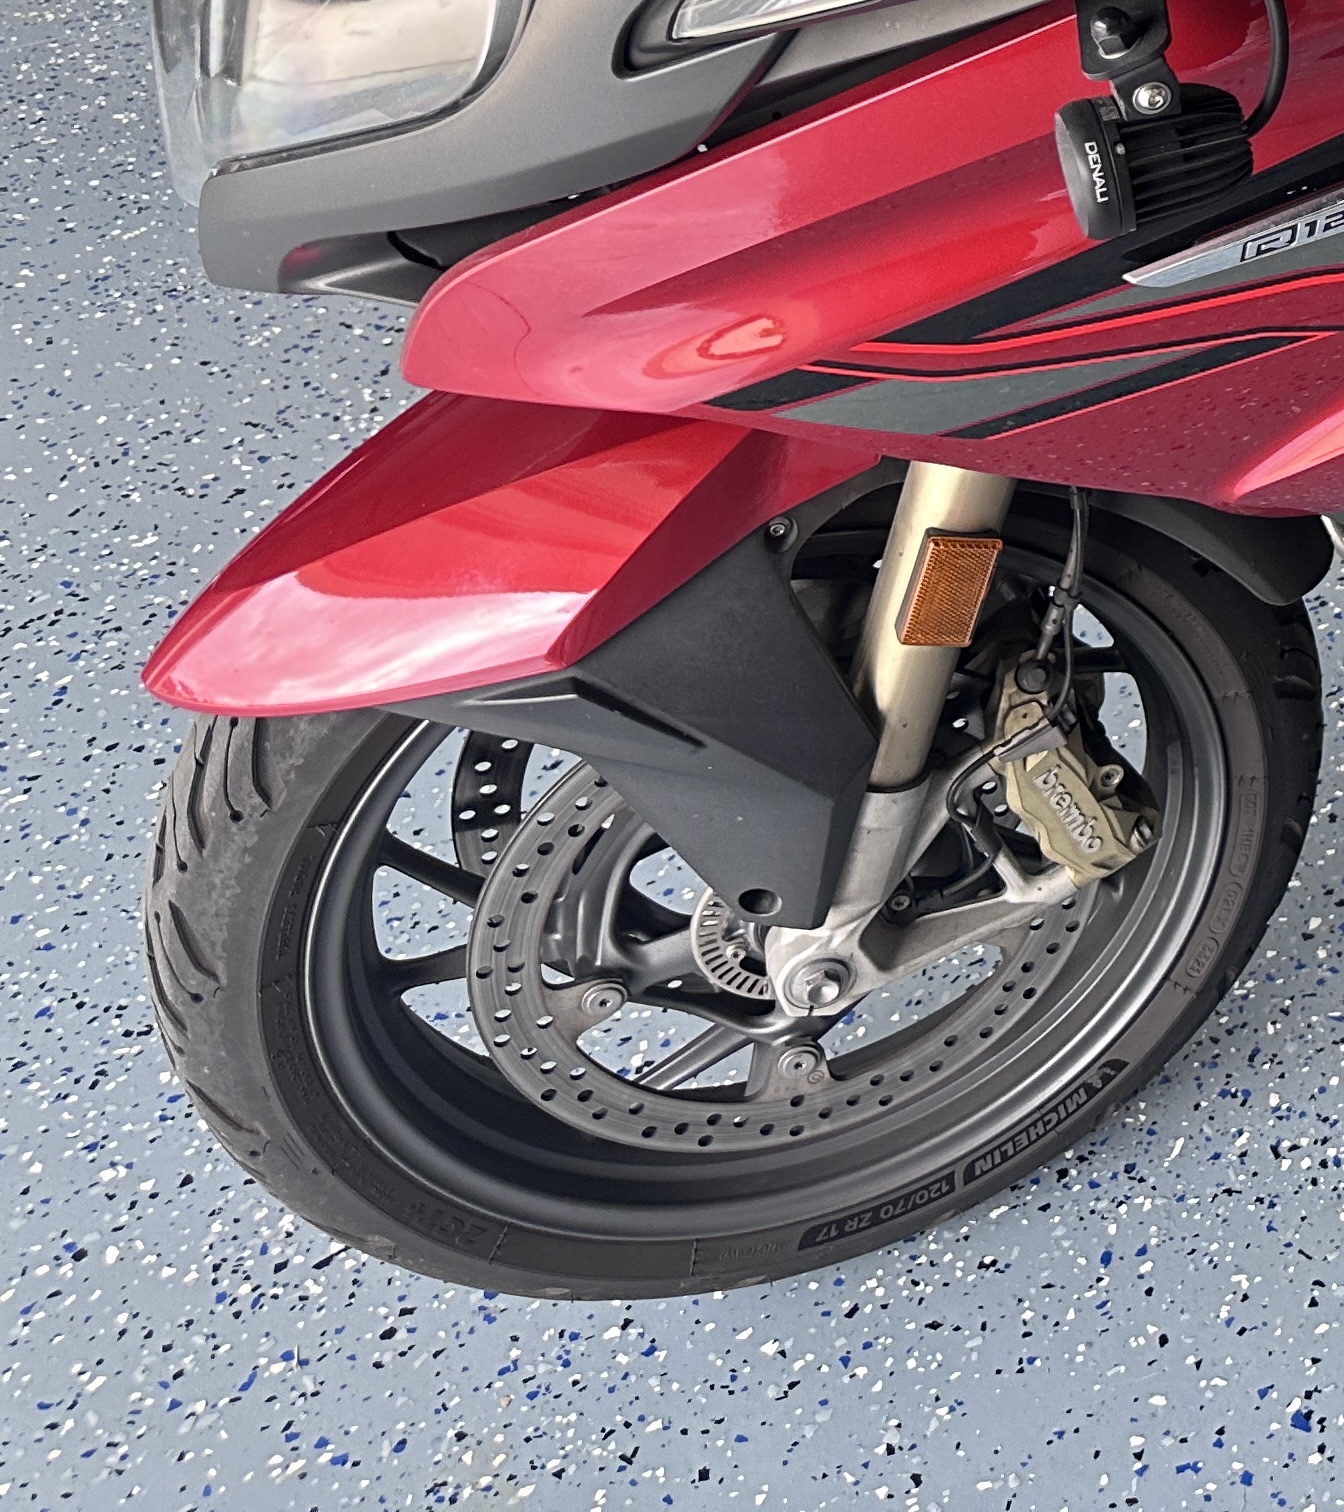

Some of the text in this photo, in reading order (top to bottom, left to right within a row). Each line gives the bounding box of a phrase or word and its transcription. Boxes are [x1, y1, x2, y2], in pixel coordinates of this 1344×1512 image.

[1084, 141, 1109, 203] DENALI
[1033, 764, 1103, 853] brembo
[973, 1088, 1089, 1176] MICHELIN
[813, 1178, 951, 1242] 120/70 ZR 17
